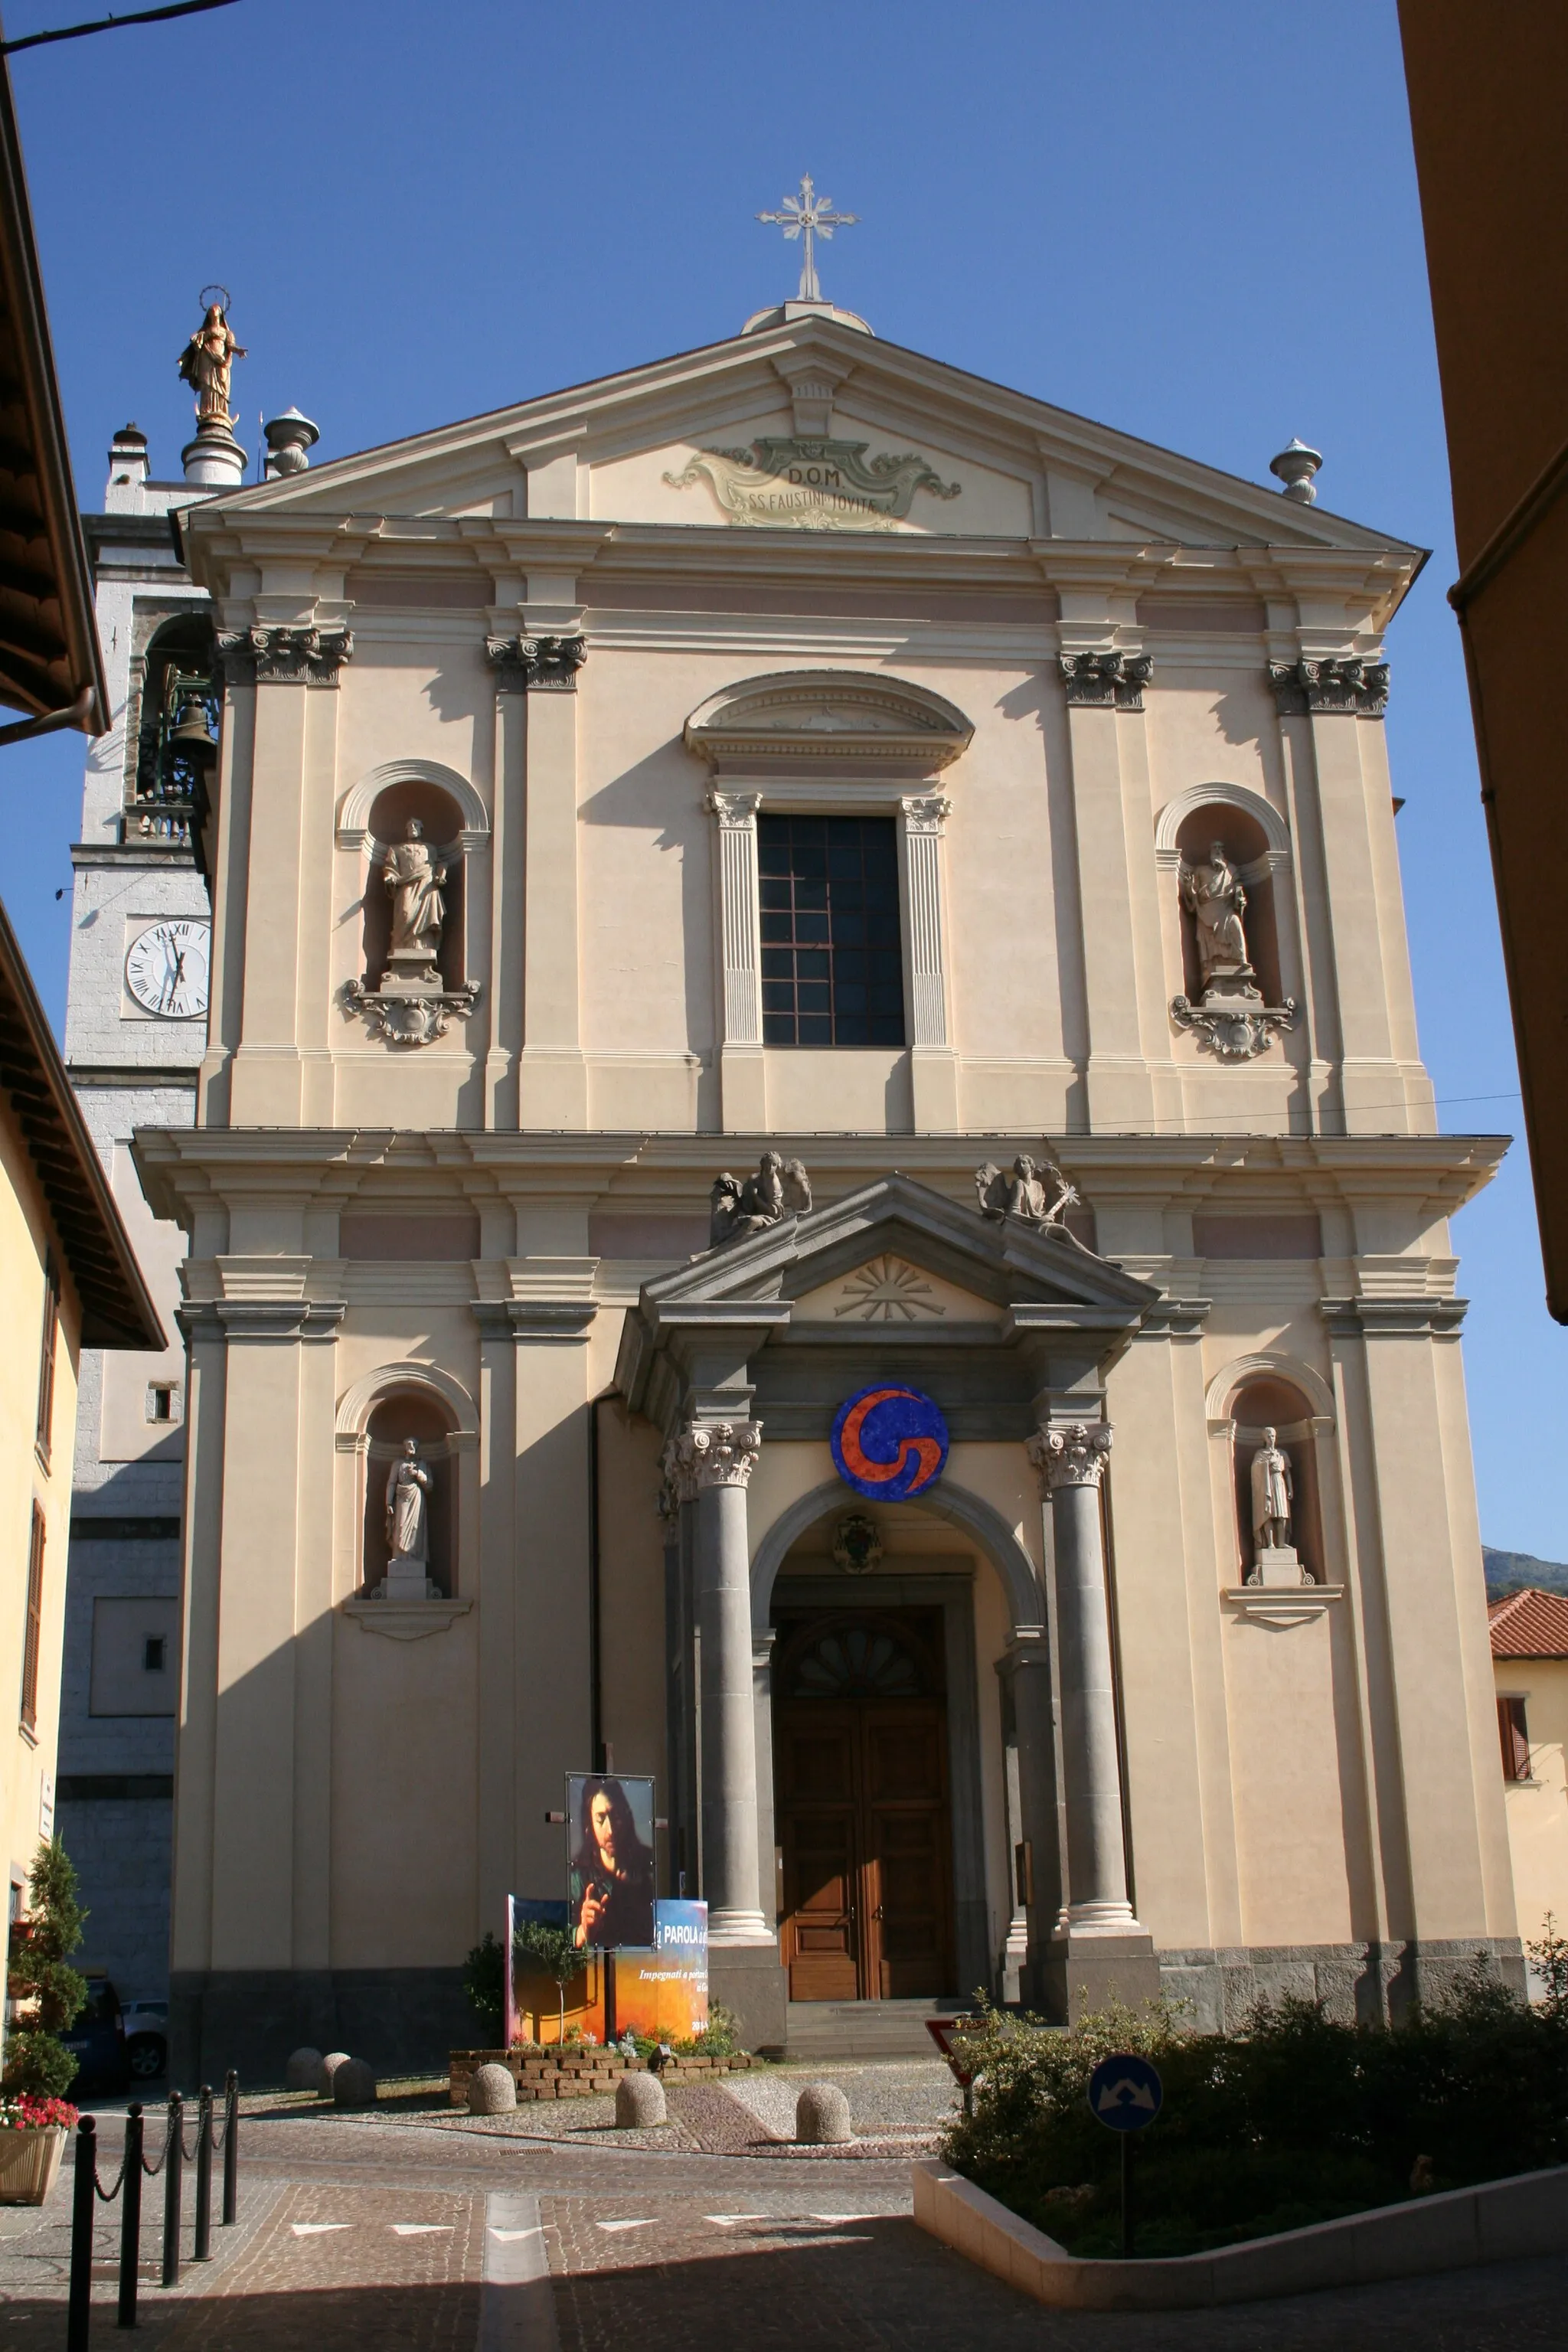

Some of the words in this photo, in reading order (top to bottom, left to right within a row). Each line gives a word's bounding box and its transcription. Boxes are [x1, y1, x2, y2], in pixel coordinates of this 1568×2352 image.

[789, 467, 845, 489] D.O.M.
[152, 927, 167, 942] XI
[175, 923, 190, 936] XII
[136, 942, 151, 954] X
[130, 962, 144, 974] IX
[664, 1925, 698, 1944] PAROLA
[639, 1968, 682, 1982] Impegnati
